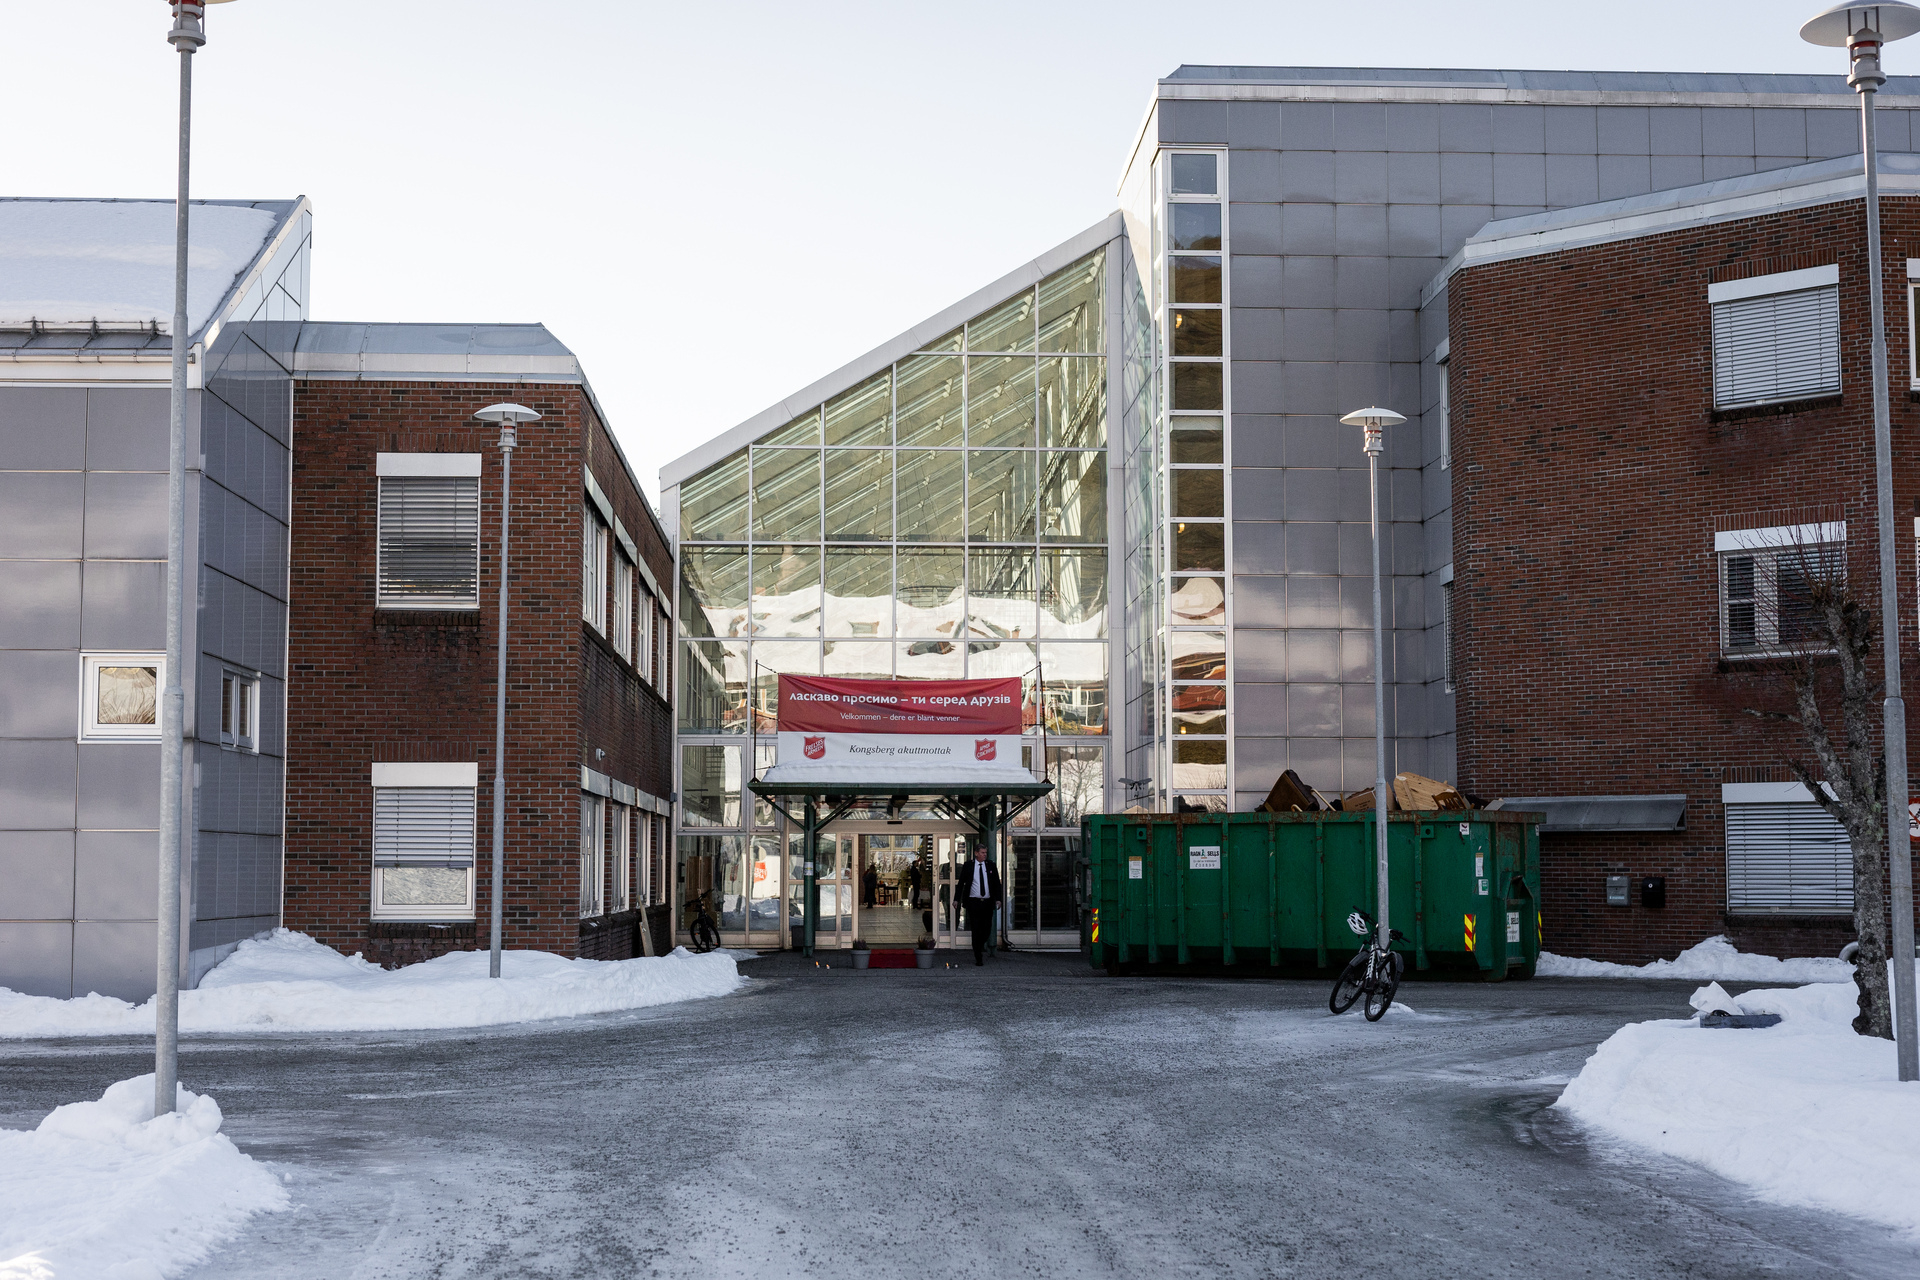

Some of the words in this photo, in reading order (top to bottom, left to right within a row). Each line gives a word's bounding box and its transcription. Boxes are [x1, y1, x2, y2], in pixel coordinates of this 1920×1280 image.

[842, 695, 898, 705] просимо
[911, 696, 926, 704] ти
[929, 696, 968, 707] серед
[970, 694, 1011, 707] друзів
[840, 712, 881, 720] Velkommen
[889, 713, 906, 721] dere
[917, 713, 935, 722] blant
[849, 744, 895, 756] Kongsberg
[897, 745, 952, 755] akuttmottak
